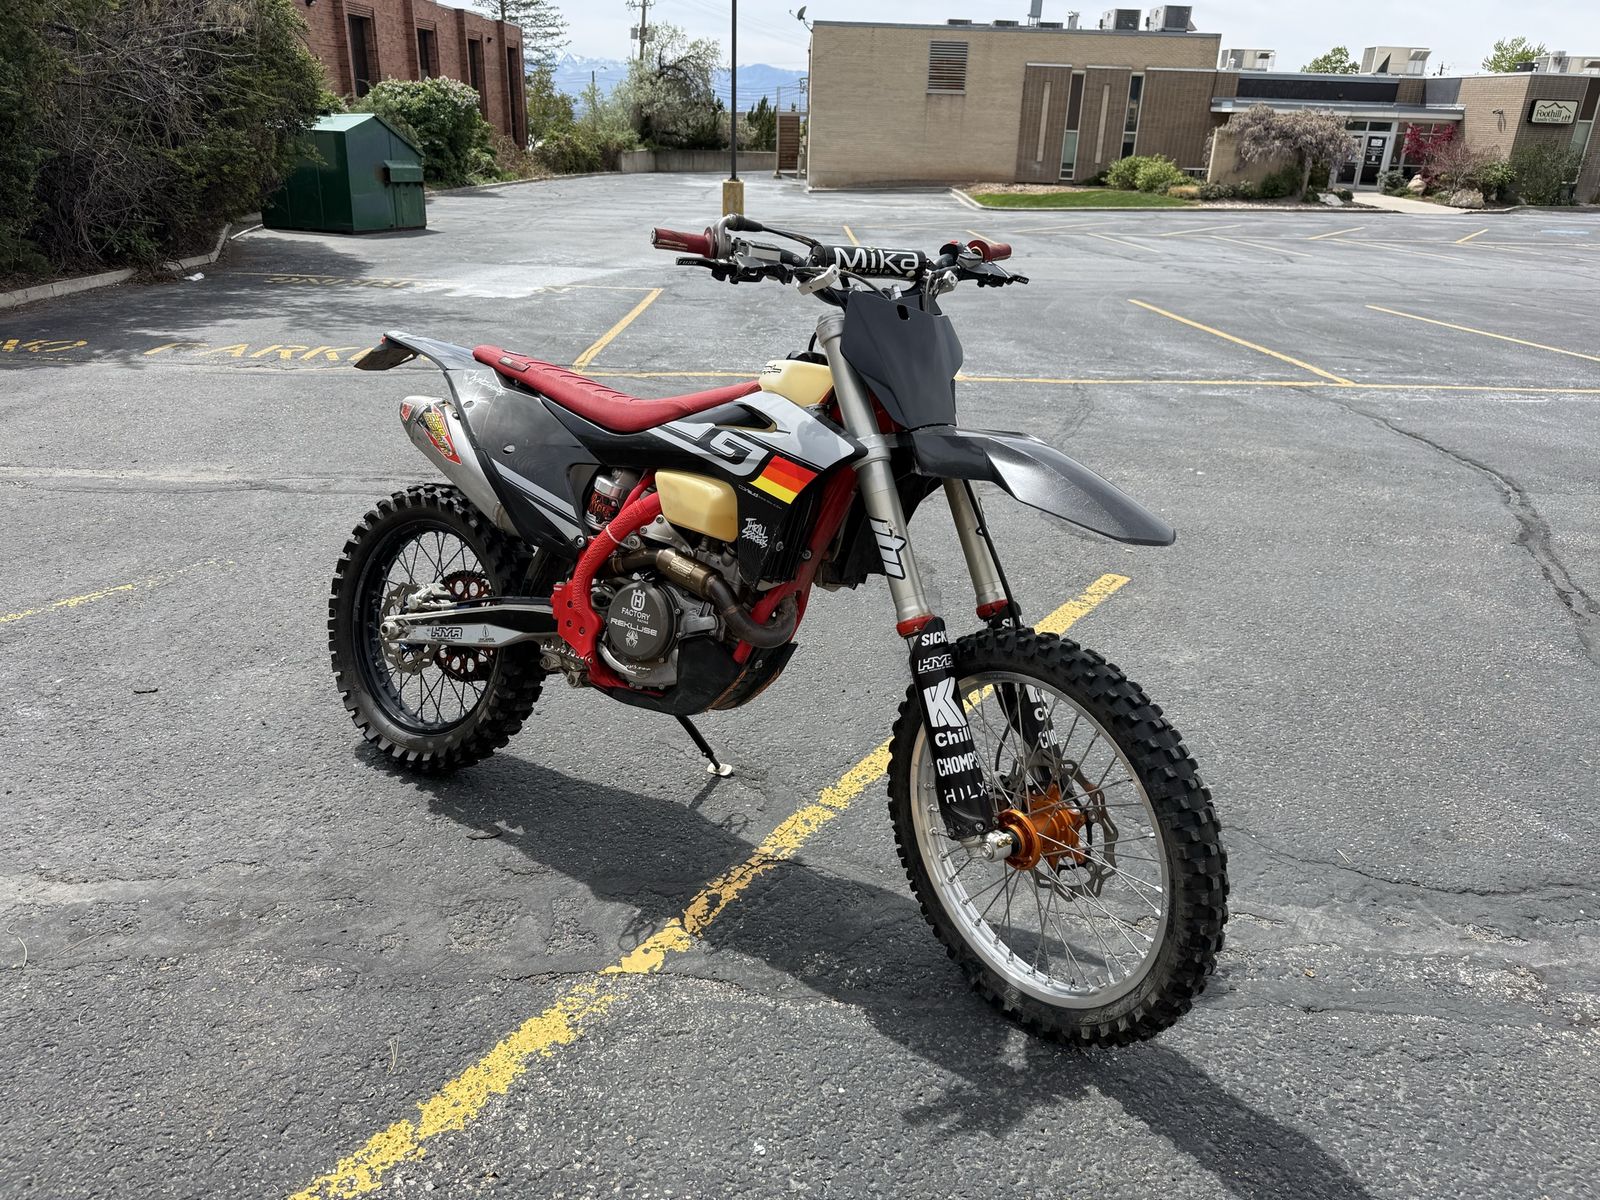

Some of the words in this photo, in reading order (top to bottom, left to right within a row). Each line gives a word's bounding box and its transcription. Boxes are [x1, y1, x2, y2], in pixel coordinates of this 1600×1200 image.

[1536, 109, 1562, 118] Foothill
[833, 247, 919, 274] Mika
[144, 342, 375, 361] PARKI
[621, 606, 651, 621] FACTORY
[610, 617, 658, 637] REKLUSE
[936, 750, 980, 777] CHOMPS
